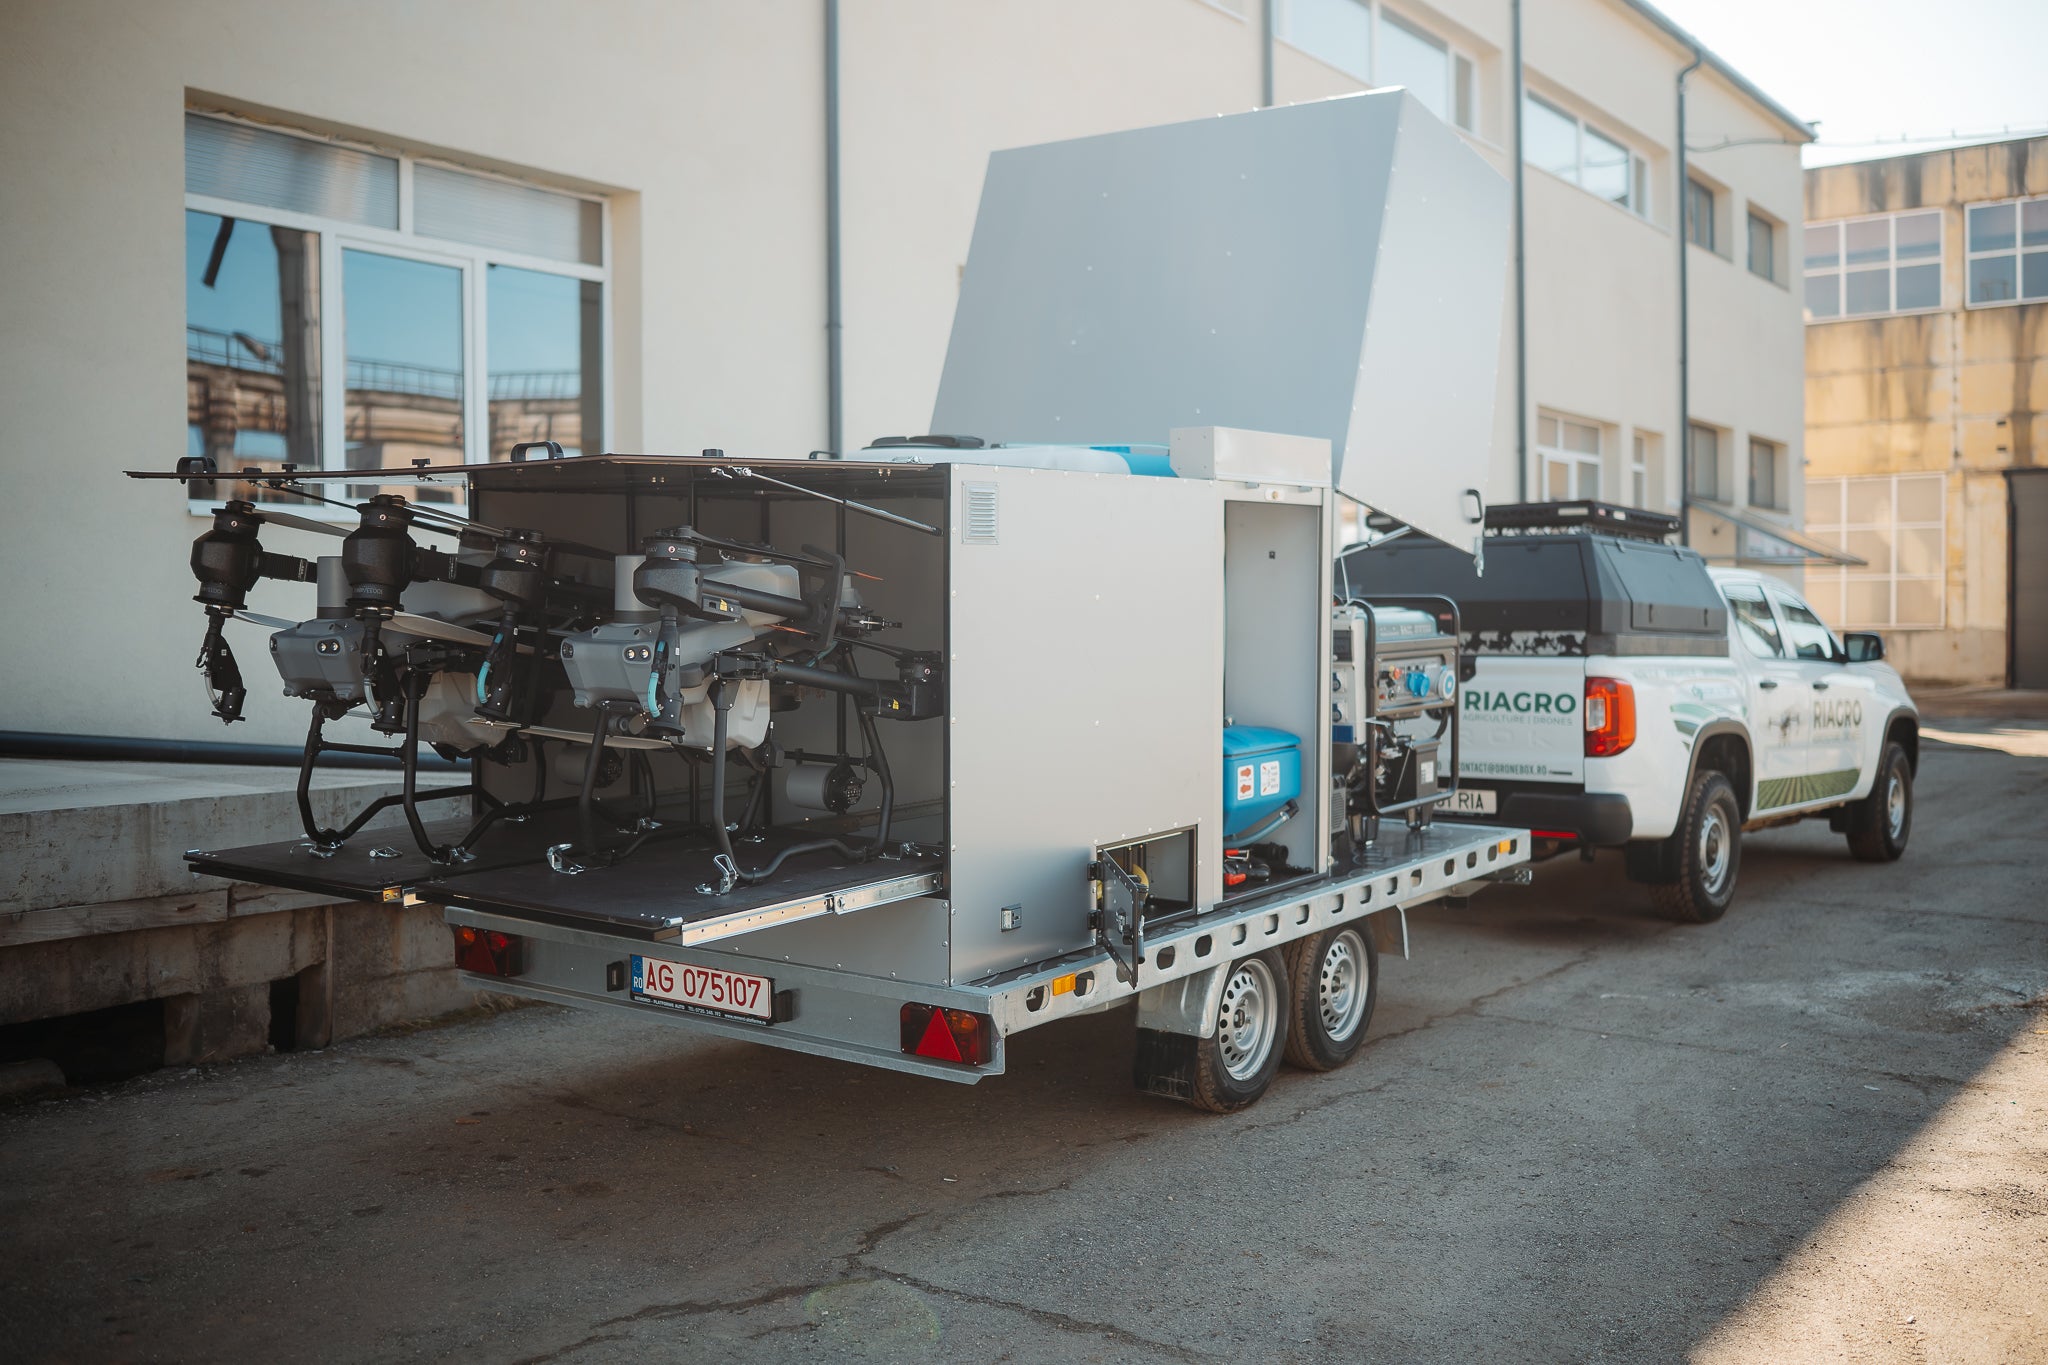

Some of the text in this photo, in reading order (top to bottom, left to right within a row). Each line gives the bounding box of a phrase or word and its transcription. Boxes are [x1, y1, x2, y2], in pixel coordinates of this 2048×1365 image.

[1464, 690, 1577, 714] RIAGRO
[1462, 714, 1525, 724] AGRICULTURE
[1533, 717, 1573, 727] DRONES
[1813, 699, 1862, 729] RIAGRO
[1458, 761, 1547, 775] ONTACT@DRONEBOX.RO
[1458, 792, 1484, 810] RIA
[633, 976, 643, 989] RO
[645, 961, 761, 1009] AG 075107
